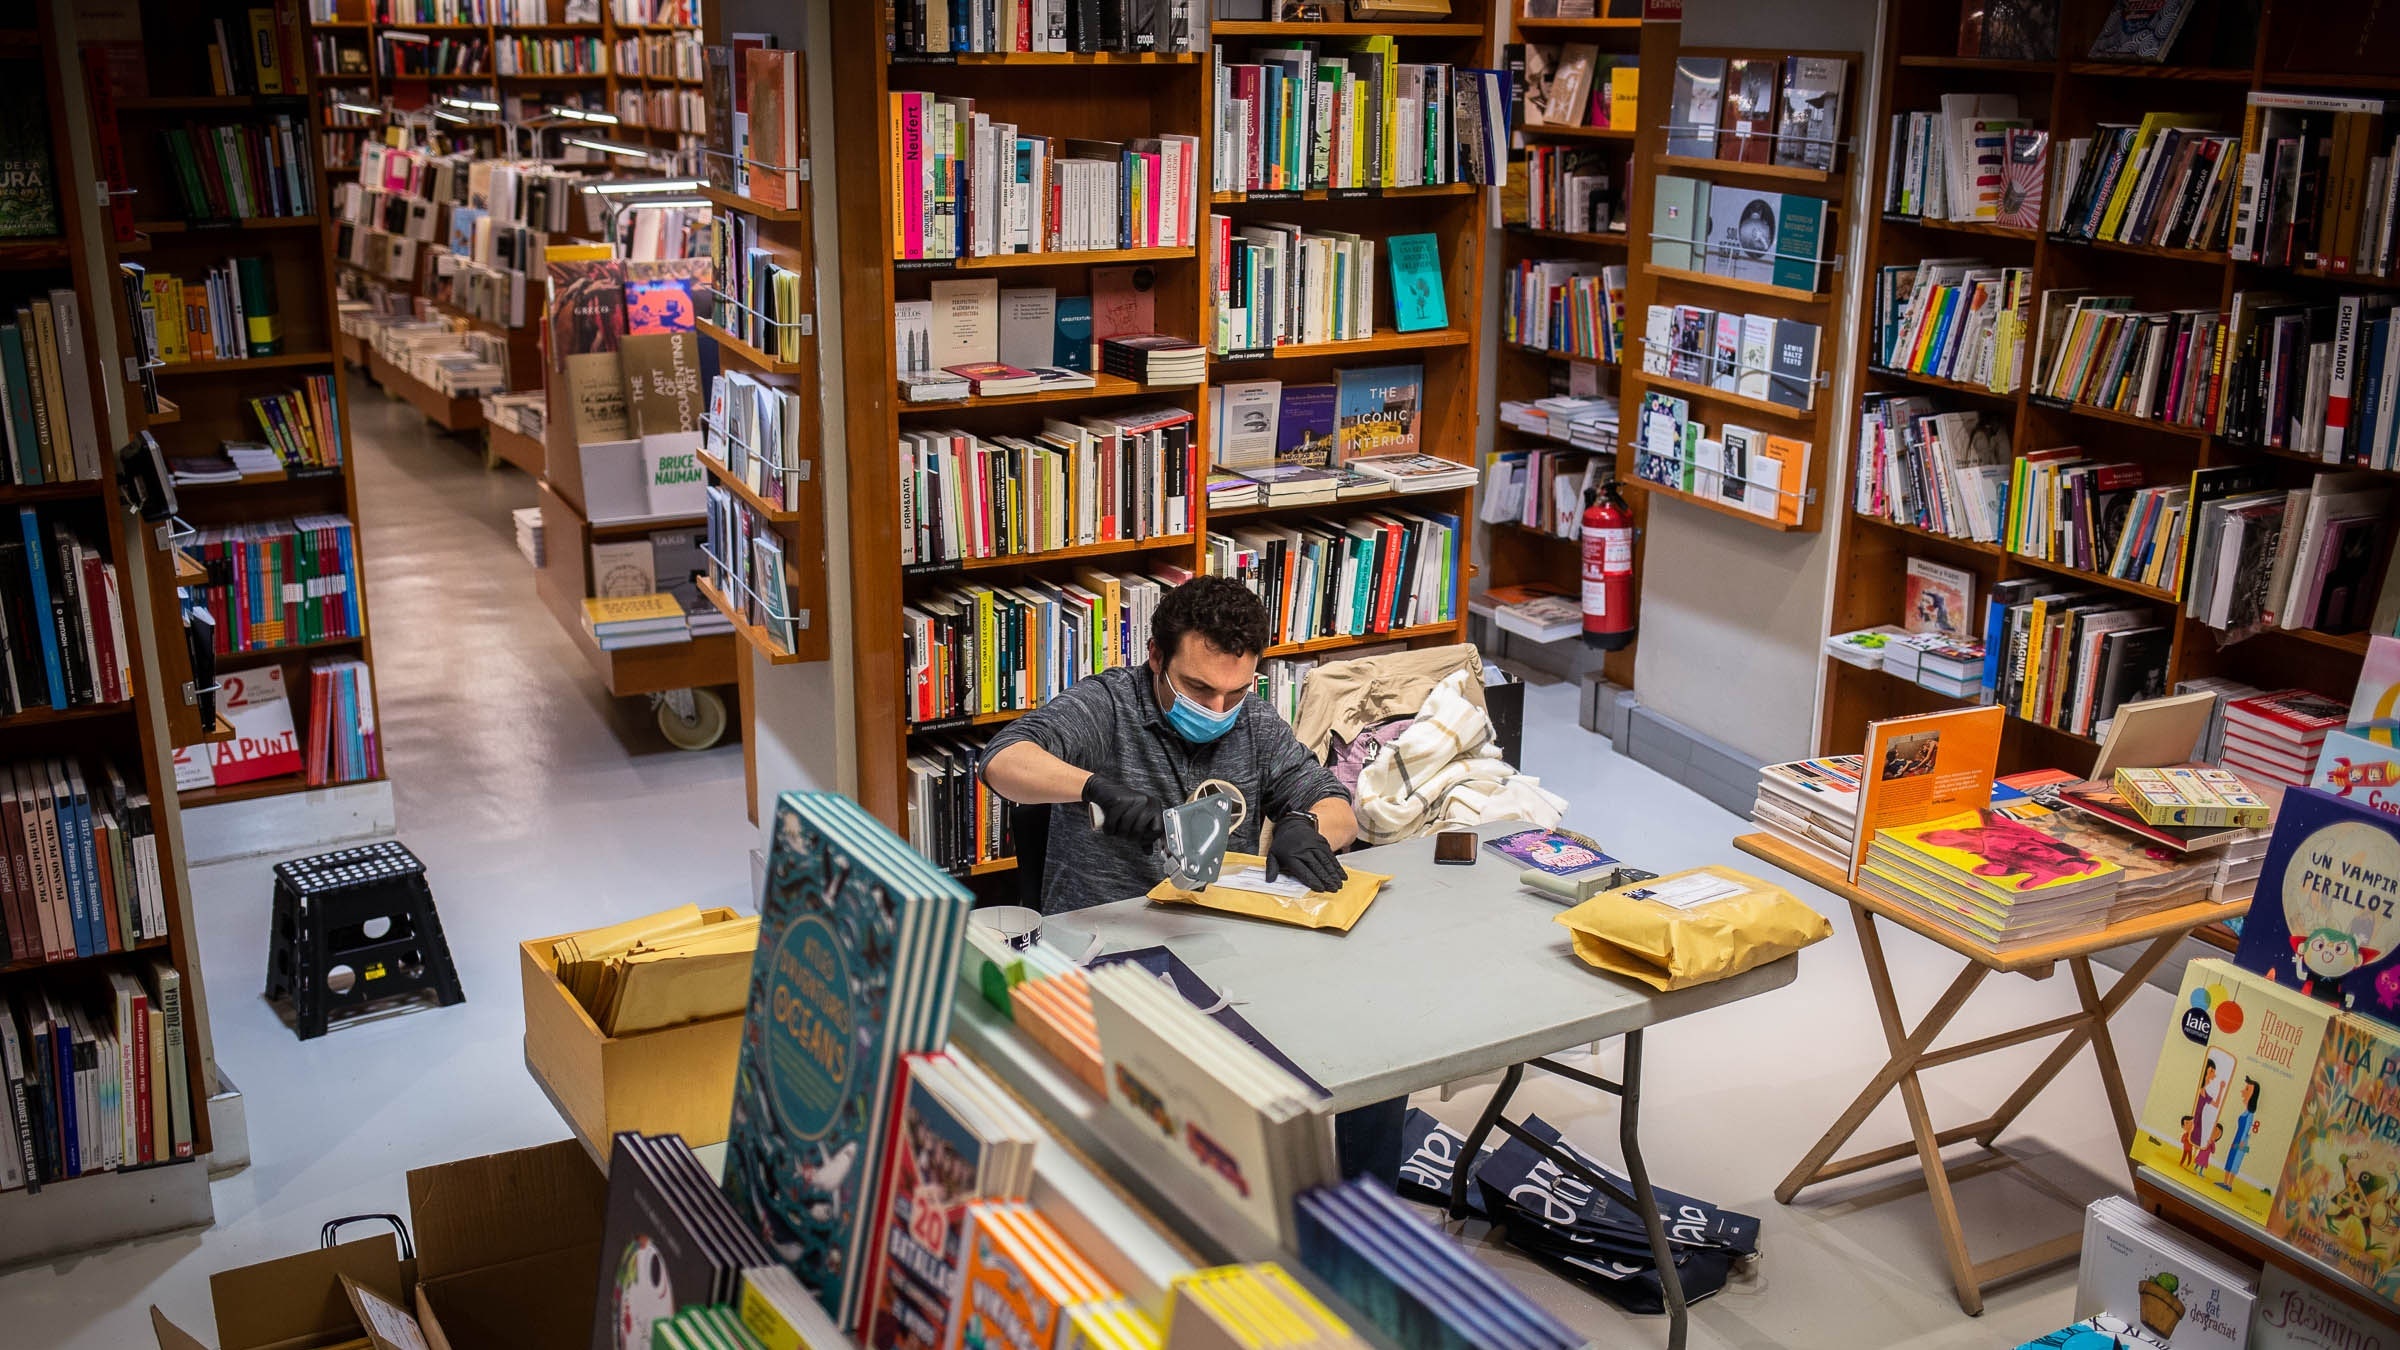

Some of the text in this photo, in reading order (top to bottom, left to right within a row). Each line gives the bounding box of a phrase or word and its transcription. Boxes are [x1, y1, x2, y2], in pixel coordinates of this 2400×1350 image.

[907, 106, 919, 161] Neufert
[1783, 344, 1803, 353] LEWIS
[2215, 324, 2226, 353] ROBERT
[2335, 306, 2352, 380] CHEMA MADOZ
[1782, 357, 1802, 366] TEXTS
[1783, 350, 1803, 360] BALTZ
[631, 375, 644, 402] THE
[652, 369, 664, 395] ART
[665, 378, 677, 396] OF
[671, 334, 693, 433] DOCUMENTING
[686, 367, 698, 394] ART
[1370, 387, 1397, 399] THE
[36, 401, 49, 445] CHAGALL
[1357, 410, 1407, 424] ICONIC
[1347, 433, 1415, 450] INTERIOR
[655, 468, 702, 486] NAUMAN
[659, 454, 694, 471] BRUCE
[2257, 531, 2281, 606] GENESIS
[57, 617, 68, 646] HOKUSAI
[2015, 632, 2028, 681] MAGNUM
[223, 677, 248, 708] 2
[216, 731, 293, 765] A PUNT
[64, 821, 75, 842] 1917.
[81, 818, 91, 839] 1917.
[28, 823, 48, 903] PICASSO PICABIA
[45, 820, 64, 900] PICASSO PICABIA
[67, 843, 77, 872] Picasso
[83, 841, 93, 870] Picasso
[0, 856, 12, 893] PICASSO
[16, 855, 29, 891] PICASSO
[2312, 852, 2398, 896] UN VAMPIR
[72, 880, 84, 920] Barcelona
[89, 883, 100, 921] Barcelona
[2302, 871, 2395, 920] PERILLOZ
[165, 988, 180, 1027] ZULOAGA
[2185, 1013, 2211, 1033] laie
[773, 984, 846, 1084] OCEANS
[2261, 1007, 2303, 1046] Mamá
[2256, 1033, 2296, 1069] Robot
[2343, 1040, 2372, 1075] LA
[13, 1084, 28, 1123] VELÁZQUEZ
[22, 1140, 34, 1161] SEGLE
[914, 1196, 944, 1252] 20
[2298, 1227, 2341, 1258] MATTHEW
[2204, 1299, 2220, 1321] gat
[2210, 1288, 2220, 1302] El
[2189, 1305, 2237, 1343] desgraciat
